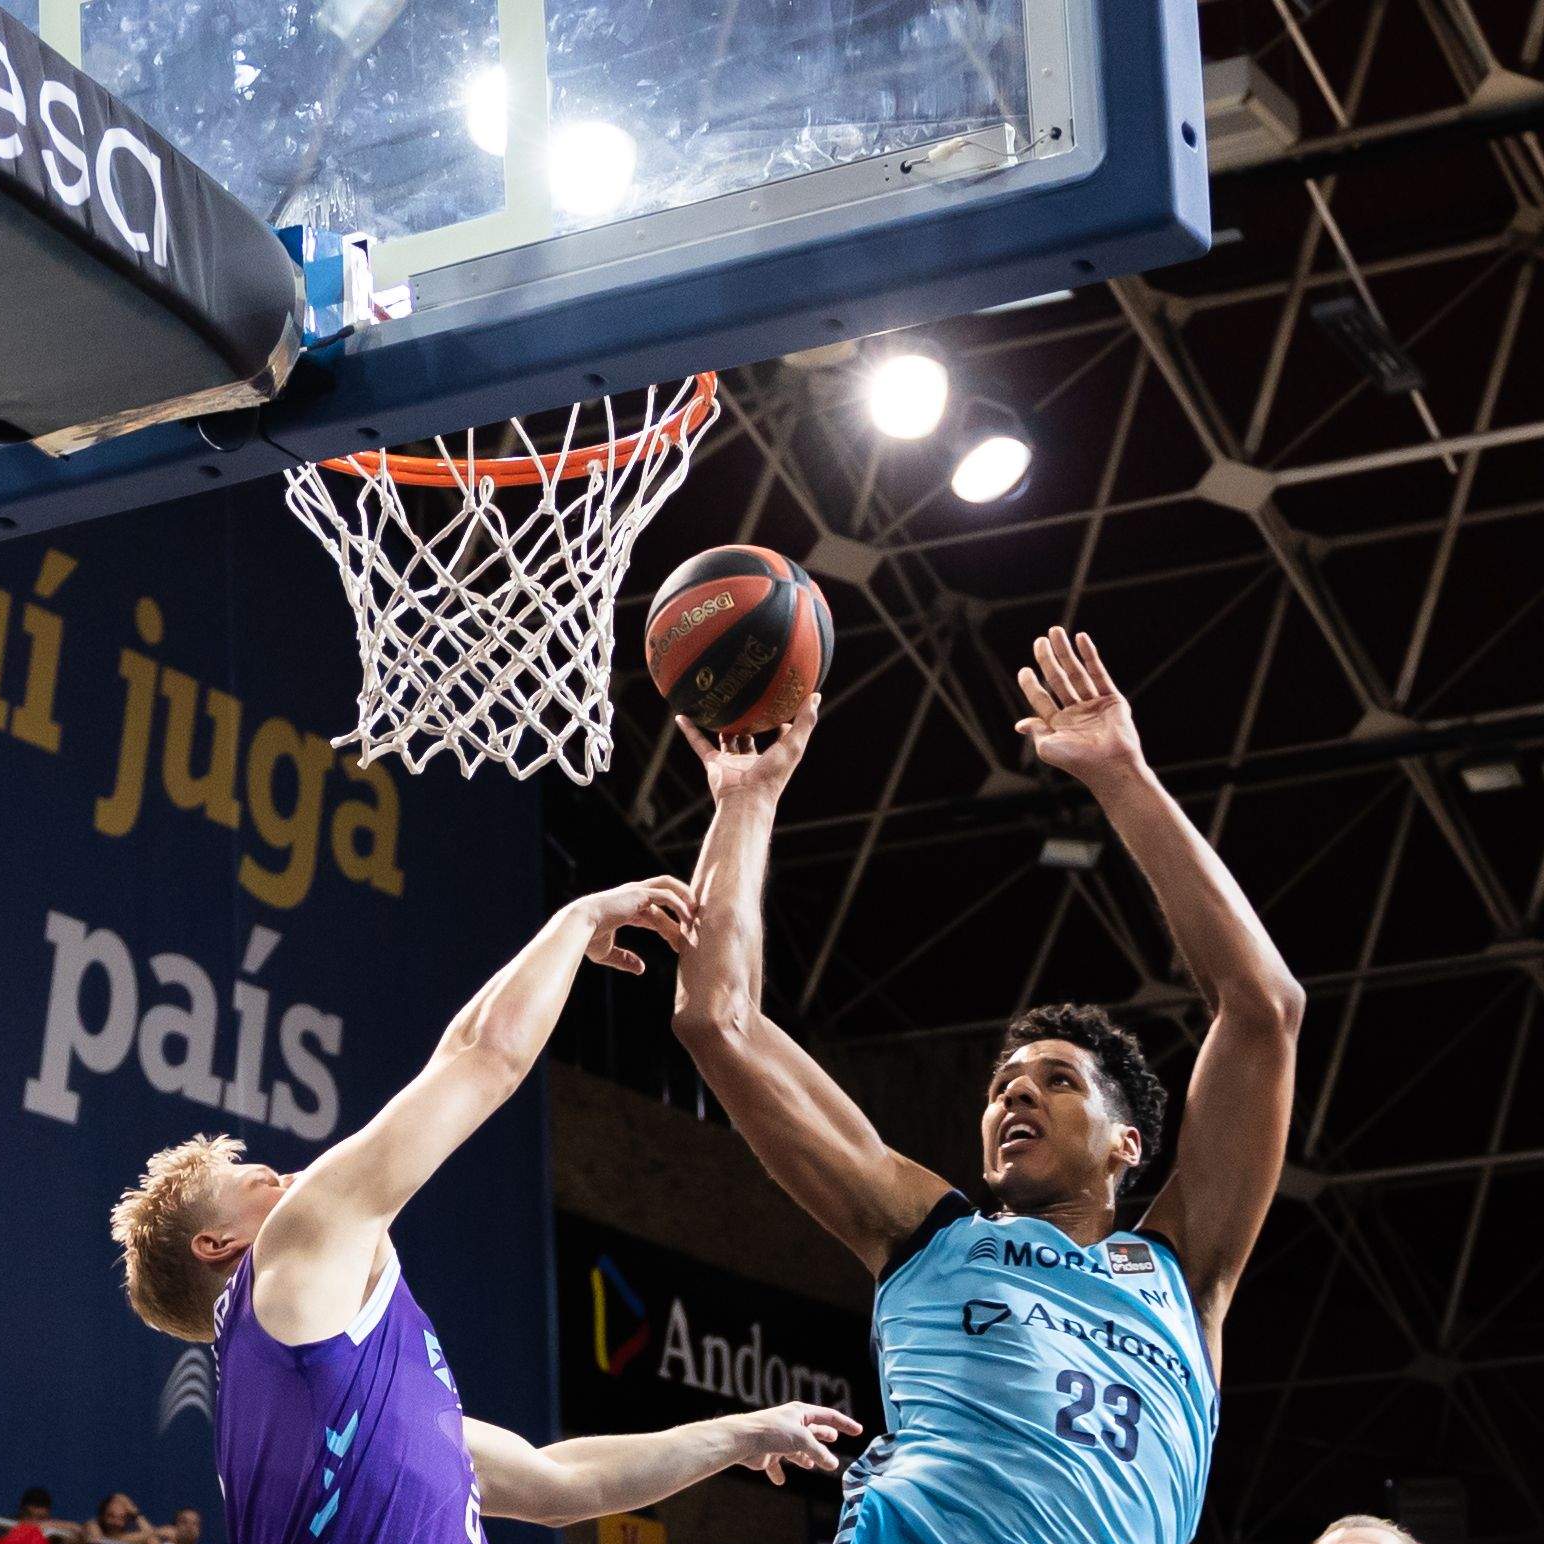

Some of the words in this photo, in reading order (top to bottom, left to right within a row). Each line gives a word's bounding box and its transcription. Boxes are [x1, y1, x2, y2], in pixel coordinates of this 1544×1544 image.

[93, 596, 405, 909] juga
[23, 925, 344, 1142] país
[657, 1298, 854, 1416] Andorra
[1055, 1368, 1142, 1463] 23
